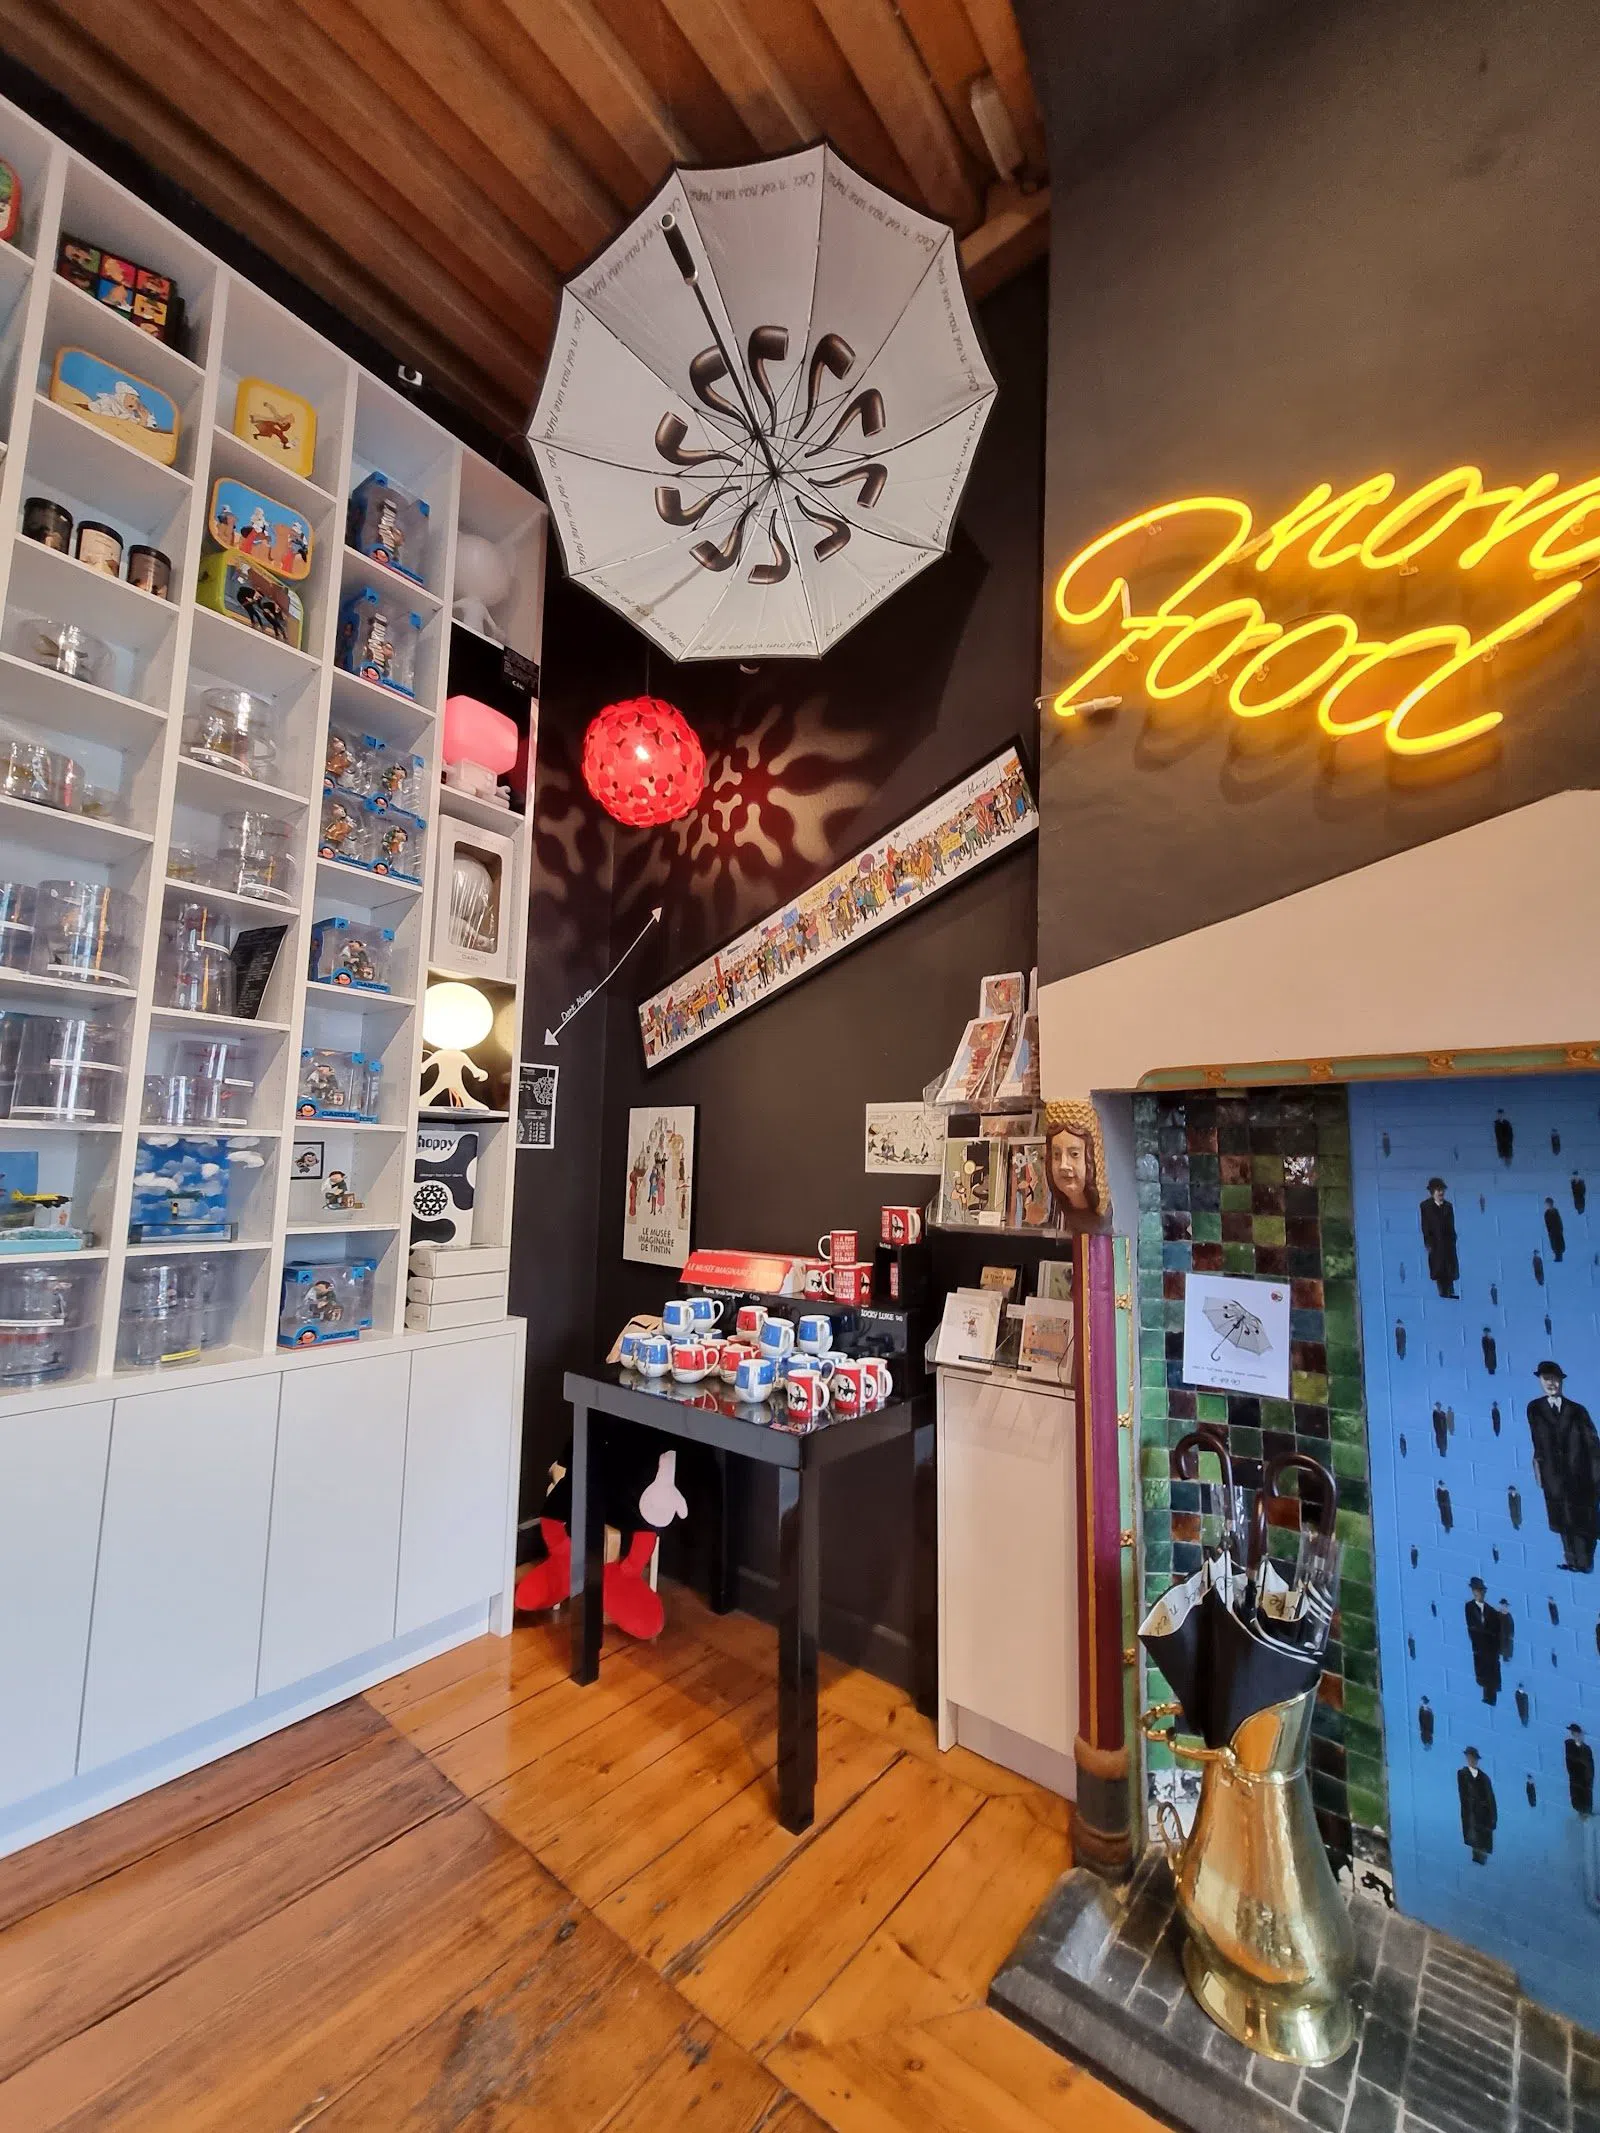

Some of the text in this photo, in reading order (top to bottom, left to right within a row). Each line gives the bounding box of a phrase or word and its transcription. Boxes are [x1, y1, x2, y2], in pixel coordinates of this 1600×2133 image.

[1054, 496, 1583, 756] Food
[642, 1227, 649, 1236] LE
[638, 1235, 674, 1248] IMAGINAIRE
[640, 1243, 671, 1255] DE TINTIN
[879, 1311, 894, 1321] LUKE
